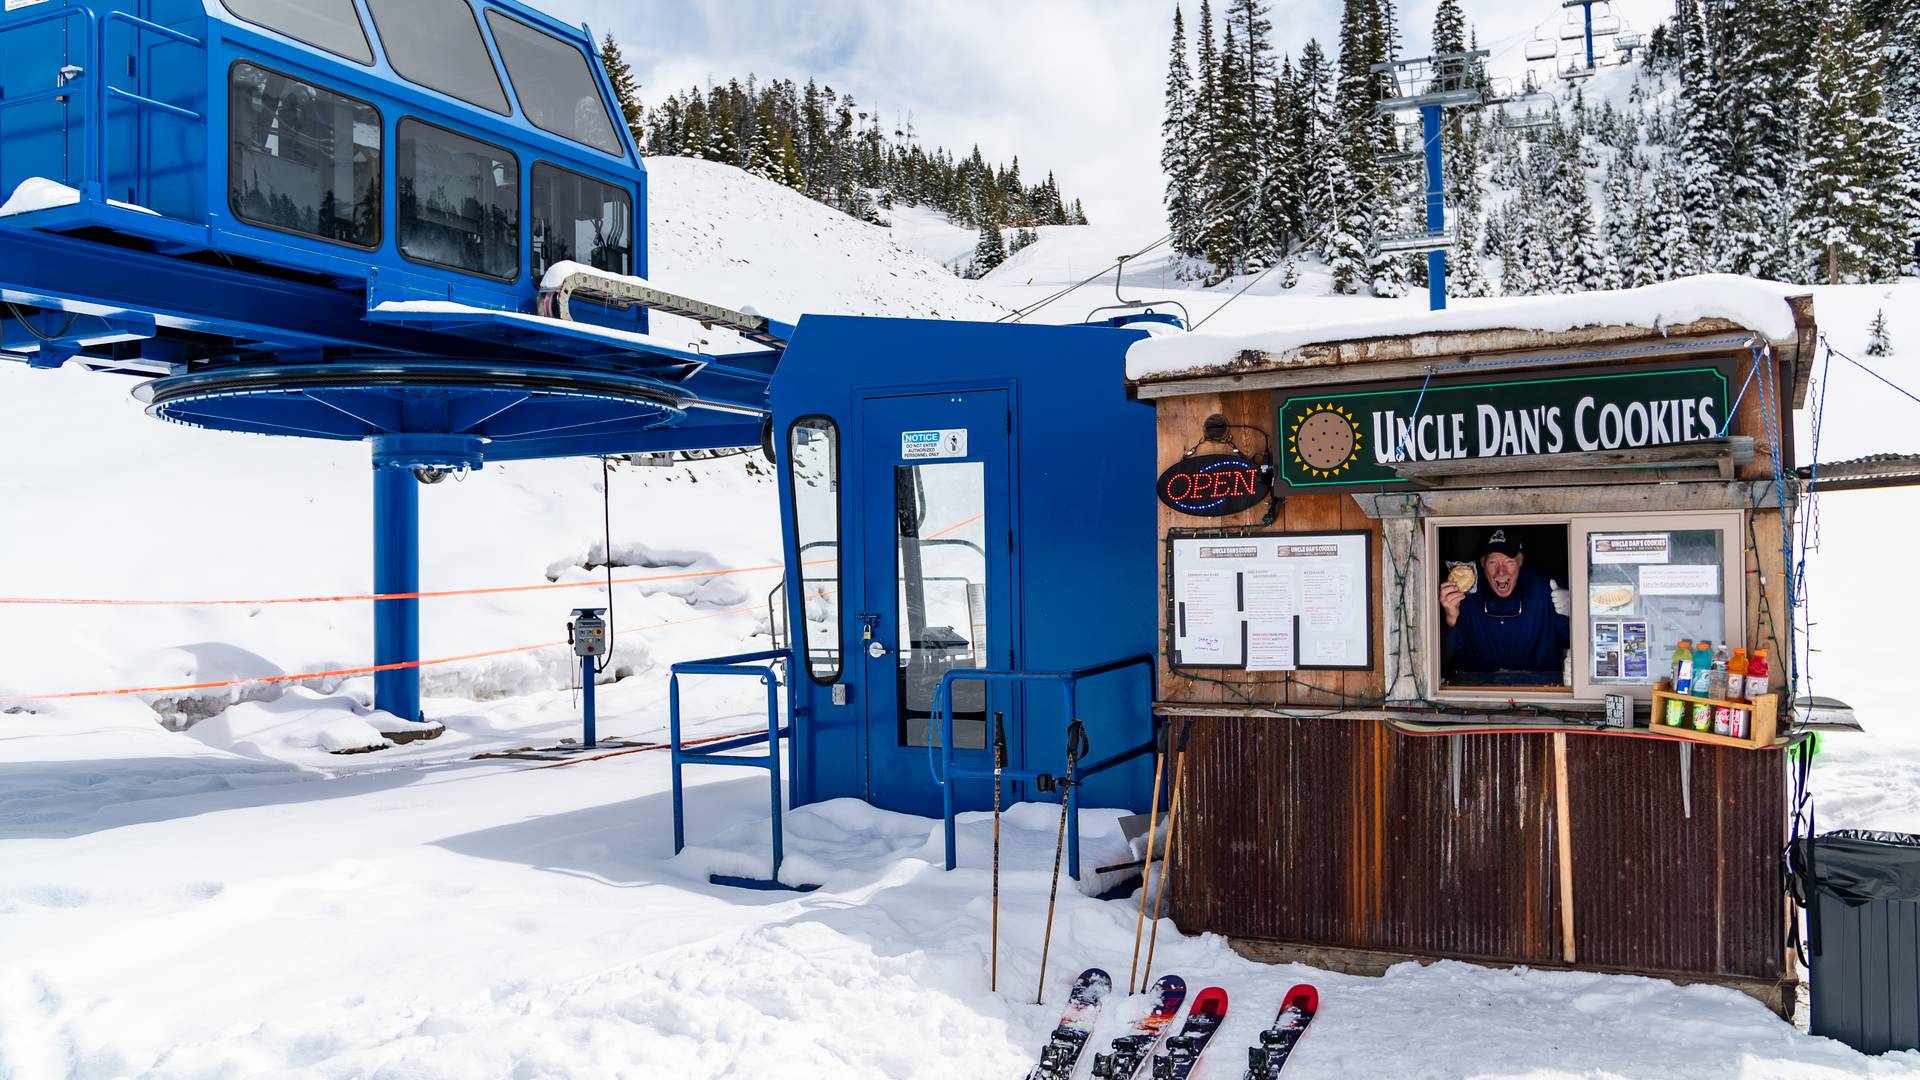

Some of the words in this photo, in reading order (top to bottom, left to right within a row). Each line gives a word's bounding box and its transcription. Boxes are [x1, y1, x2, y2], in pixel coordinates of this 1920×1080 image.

[905, 433, 938, 442] NOTICE
[1372, 410, 1467, 464] UNCLE
[1476, 404, 1564, 458] DAN'S
[1574, 396, 1717, 452] COOKIES
[1167, 468, 1258, 501] OPEN
[1628, 539, 1644, 547] DAN'S
[1644, 539, 1665, 547] COOKIES
